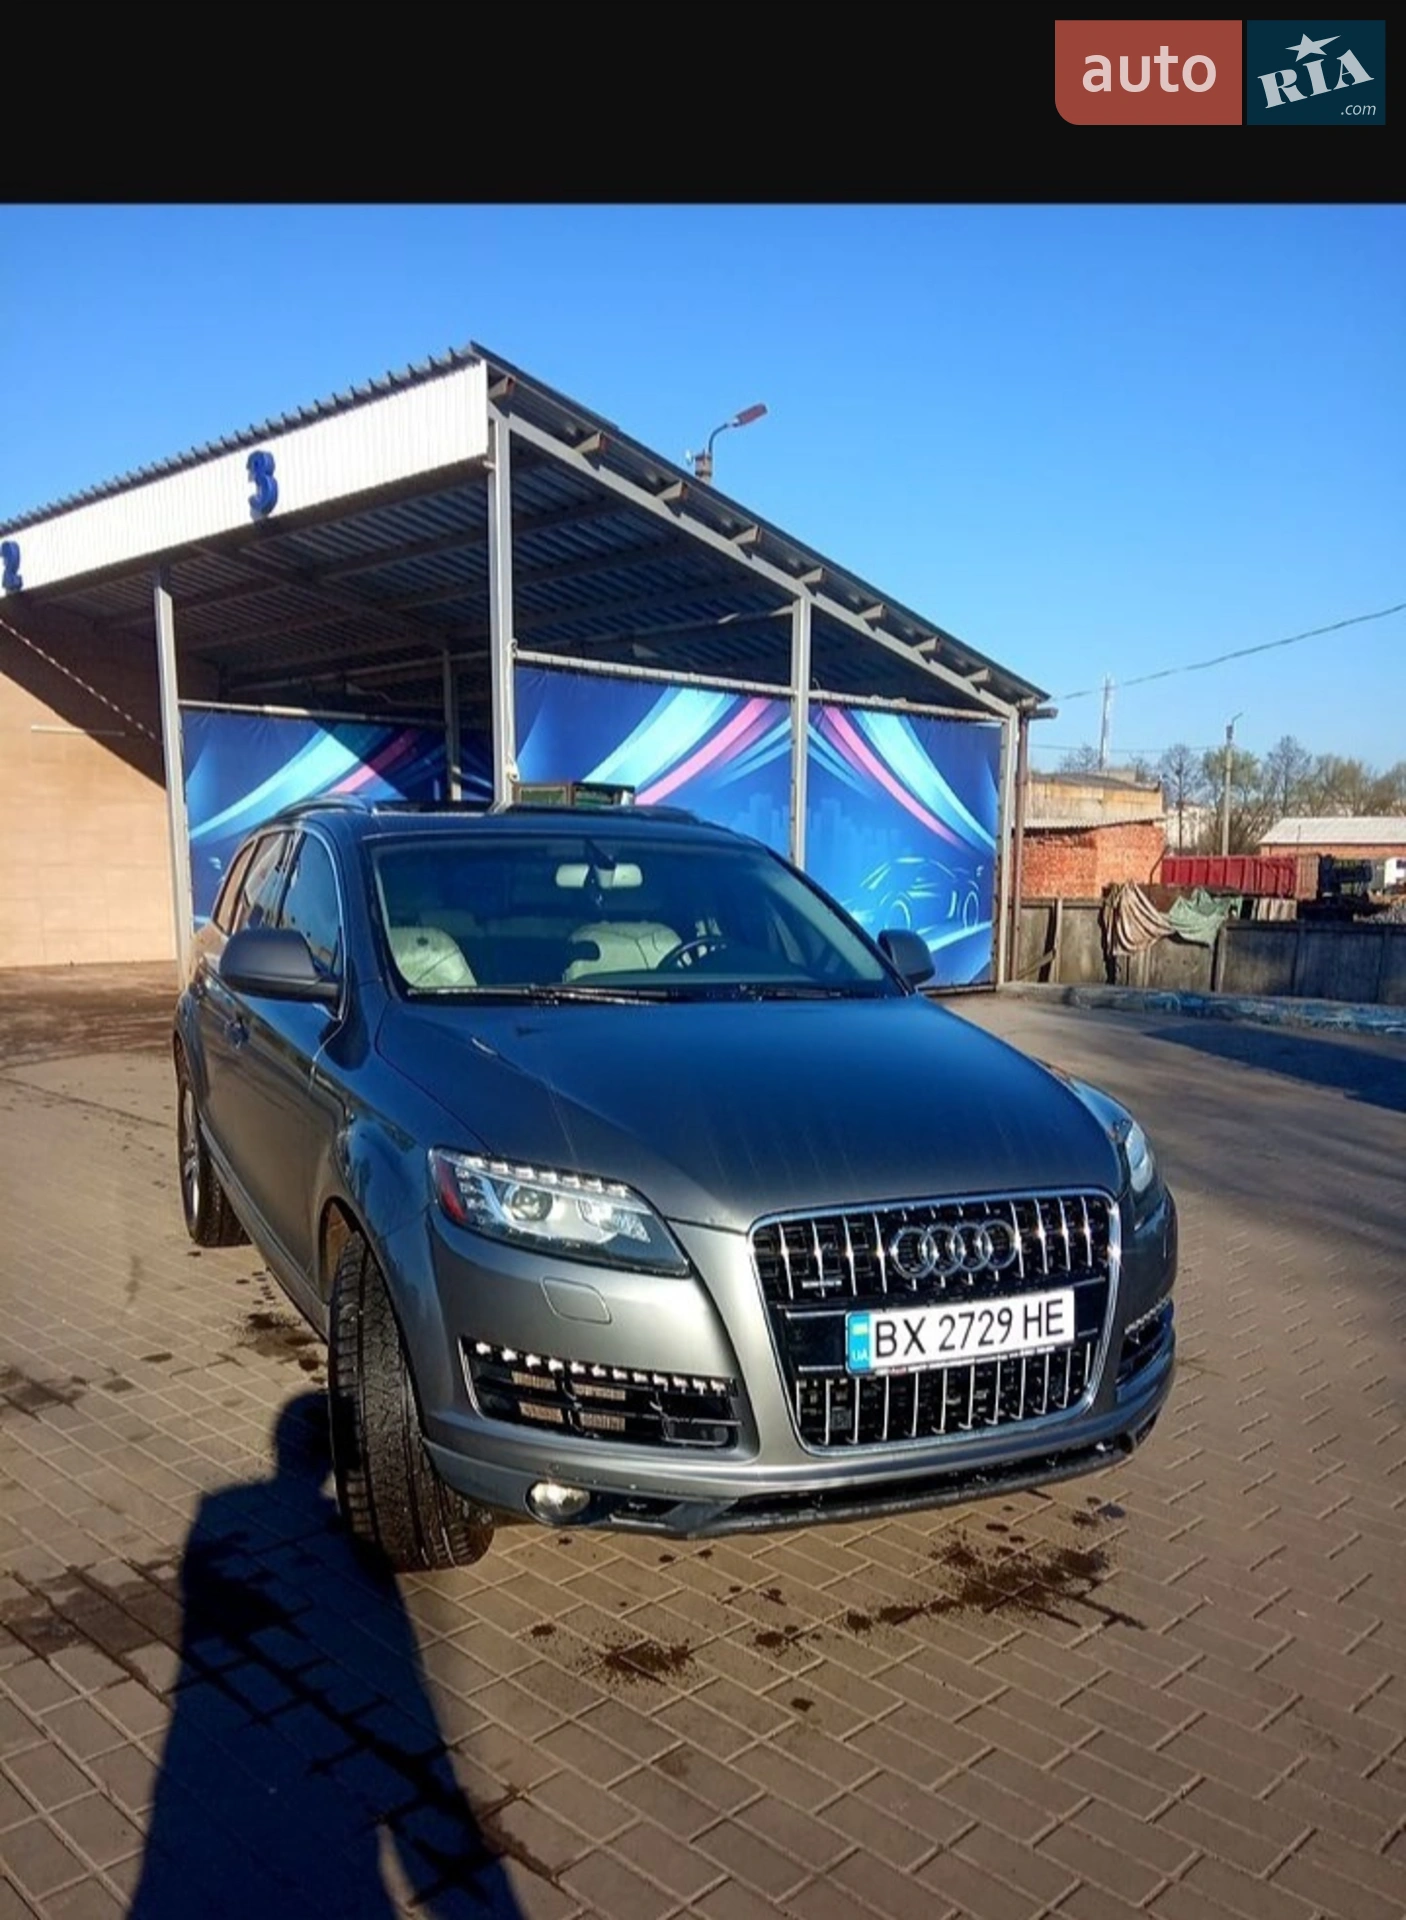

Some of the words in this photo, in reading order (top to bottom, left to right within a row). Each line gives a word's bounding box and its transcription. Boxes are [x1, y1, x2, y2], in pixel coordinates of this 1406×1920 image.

[246, 450, 279, 520] 3
[0, 540, 23, 593] 2
[875, 1316, 926, 1359] BX
[938, 1306, 1014, 1351] 2729
[1023, 1298, 1065, 1341] HE
